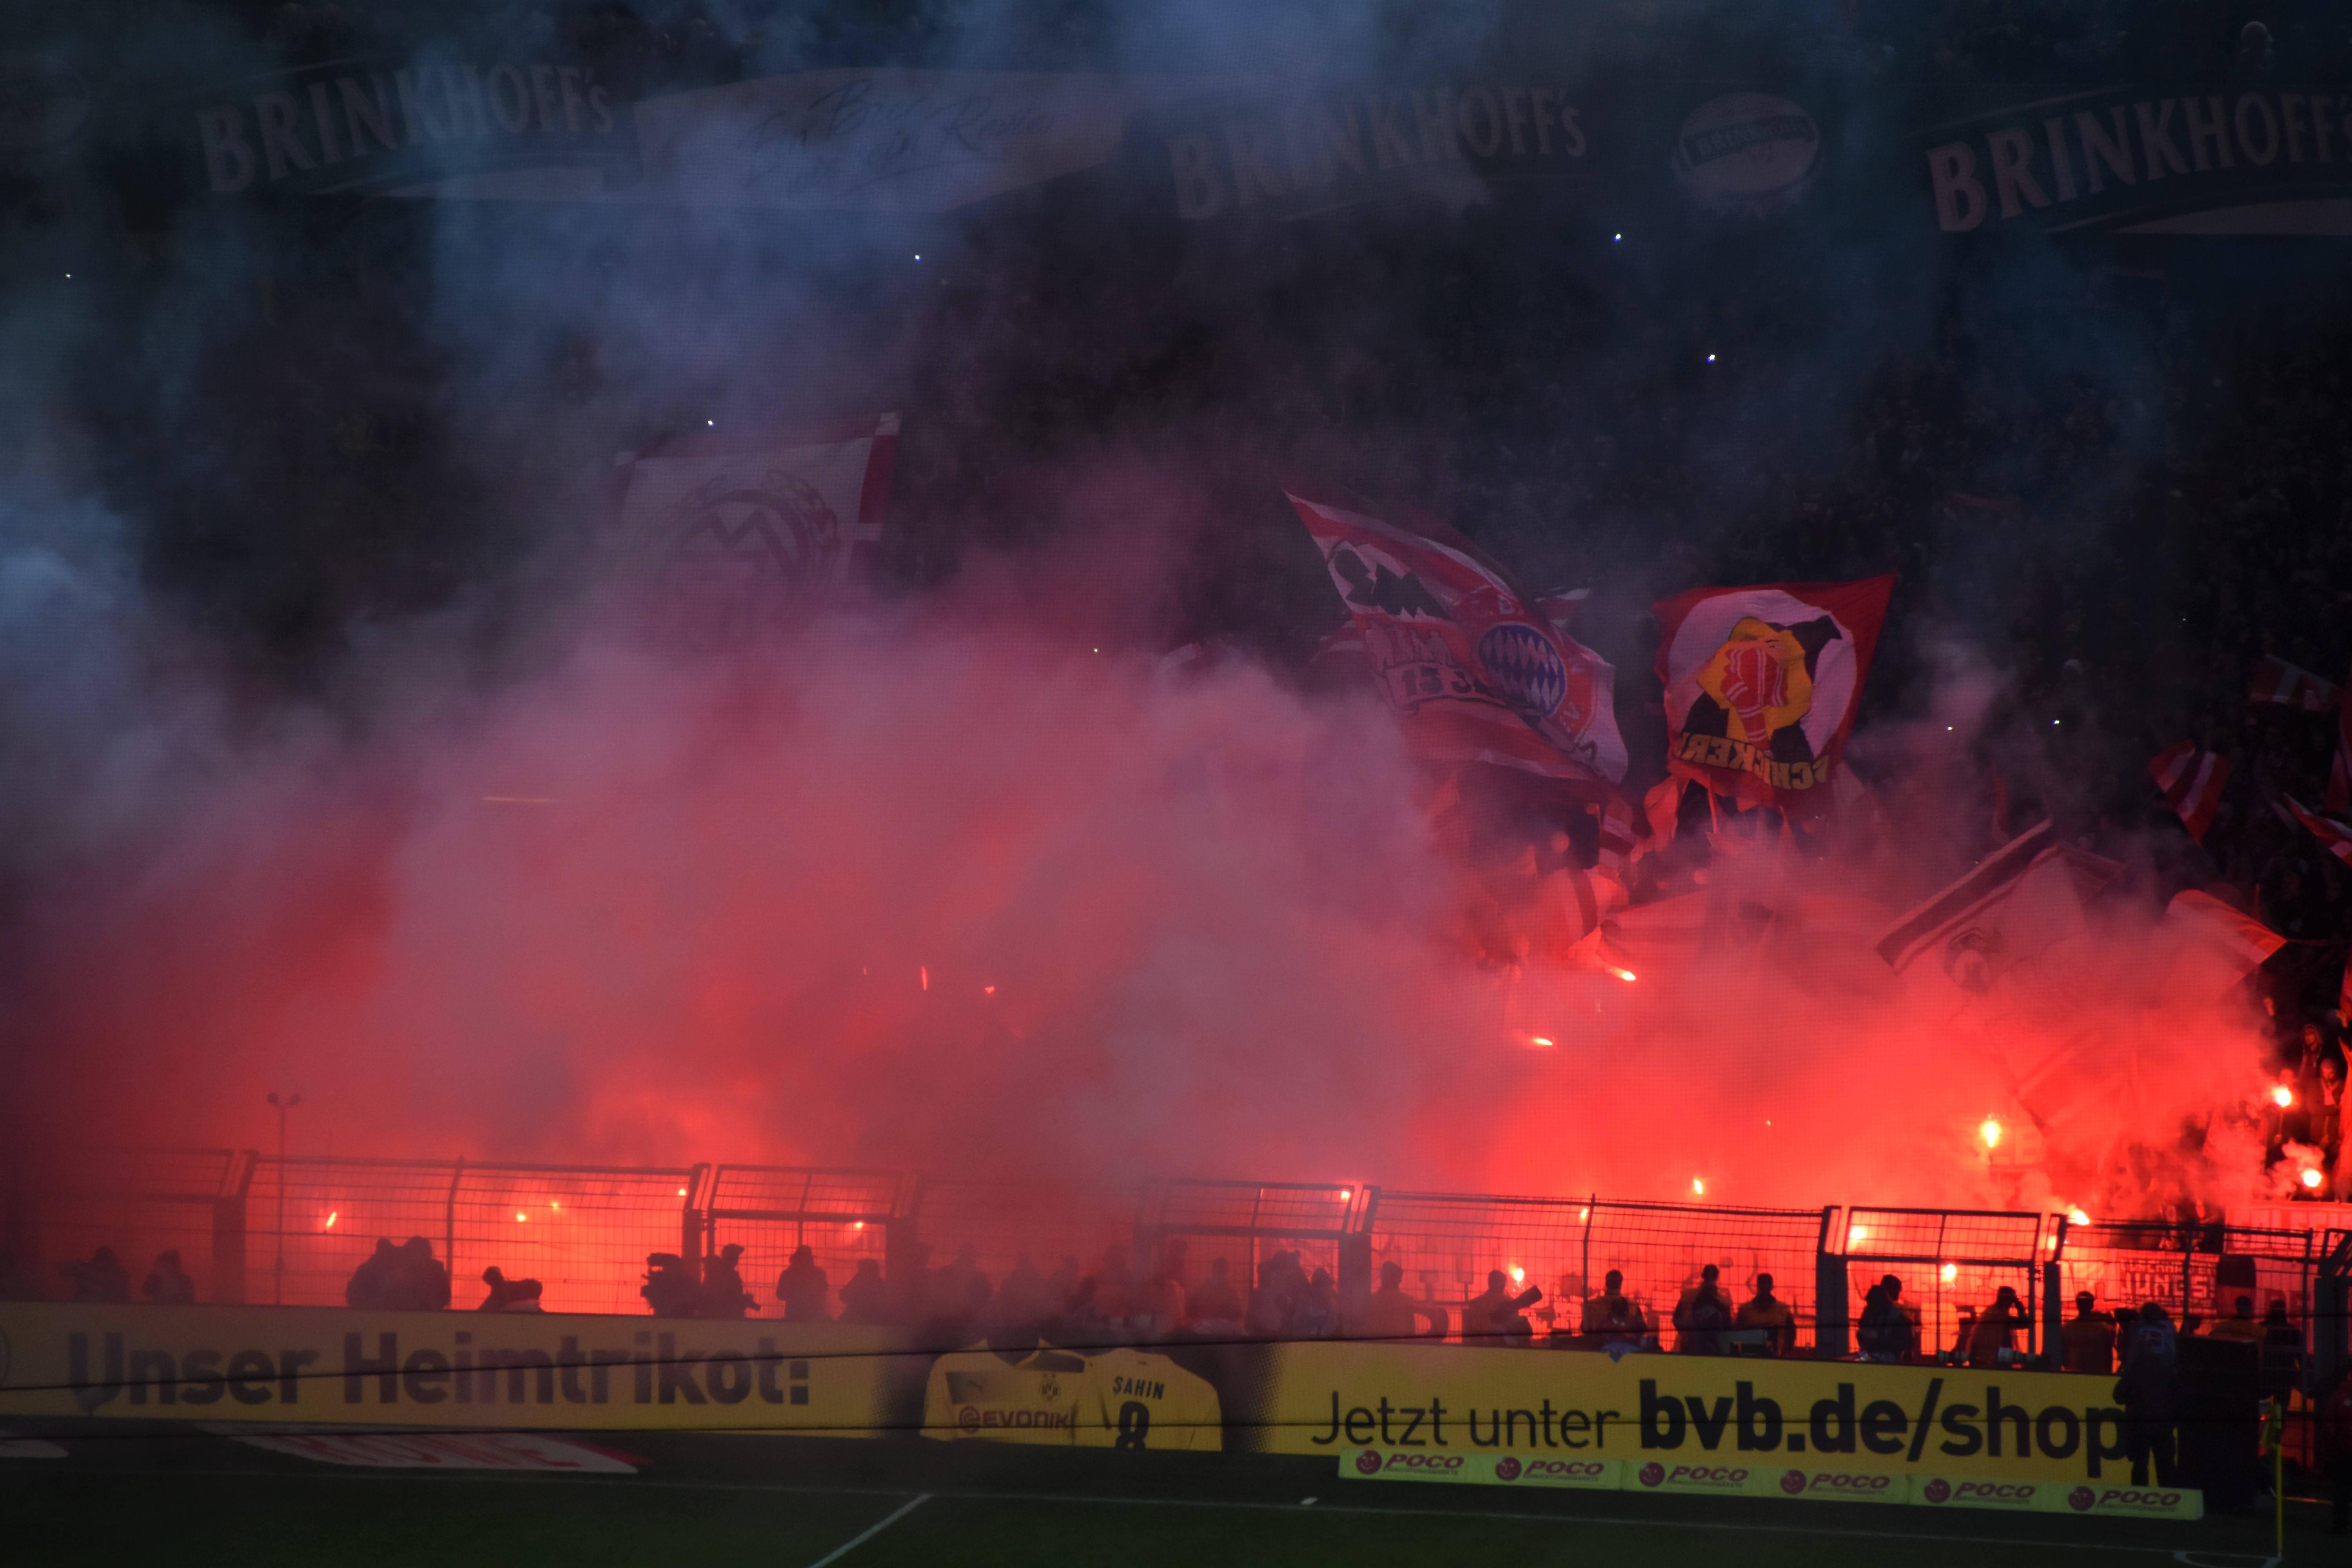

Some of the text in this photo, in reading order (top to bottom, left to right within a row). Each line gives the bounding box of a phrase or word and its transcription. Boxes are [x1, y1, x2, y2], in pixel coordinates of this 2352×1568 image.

[69, 1331, 810, 1406] Unser Heimtrikot:
[1112, 1376, 1164, 1400] SAHIN
[1115, 1401, 1150, 1450] 8
[1311, 1378, 2133, 1478] Jetzt unter bvb.de/shop
[1383, 1454, 1465, 1469] POCO
[1524, 1460, 1605, 1476] POCO
[1668, 1466, 1749, 1483] POCO
[1808, 1473, 1891, 1490] POCO
[1952, 1482, 2036, 1499] POCO
[2097, 1490, 2182, 1507] POCO
